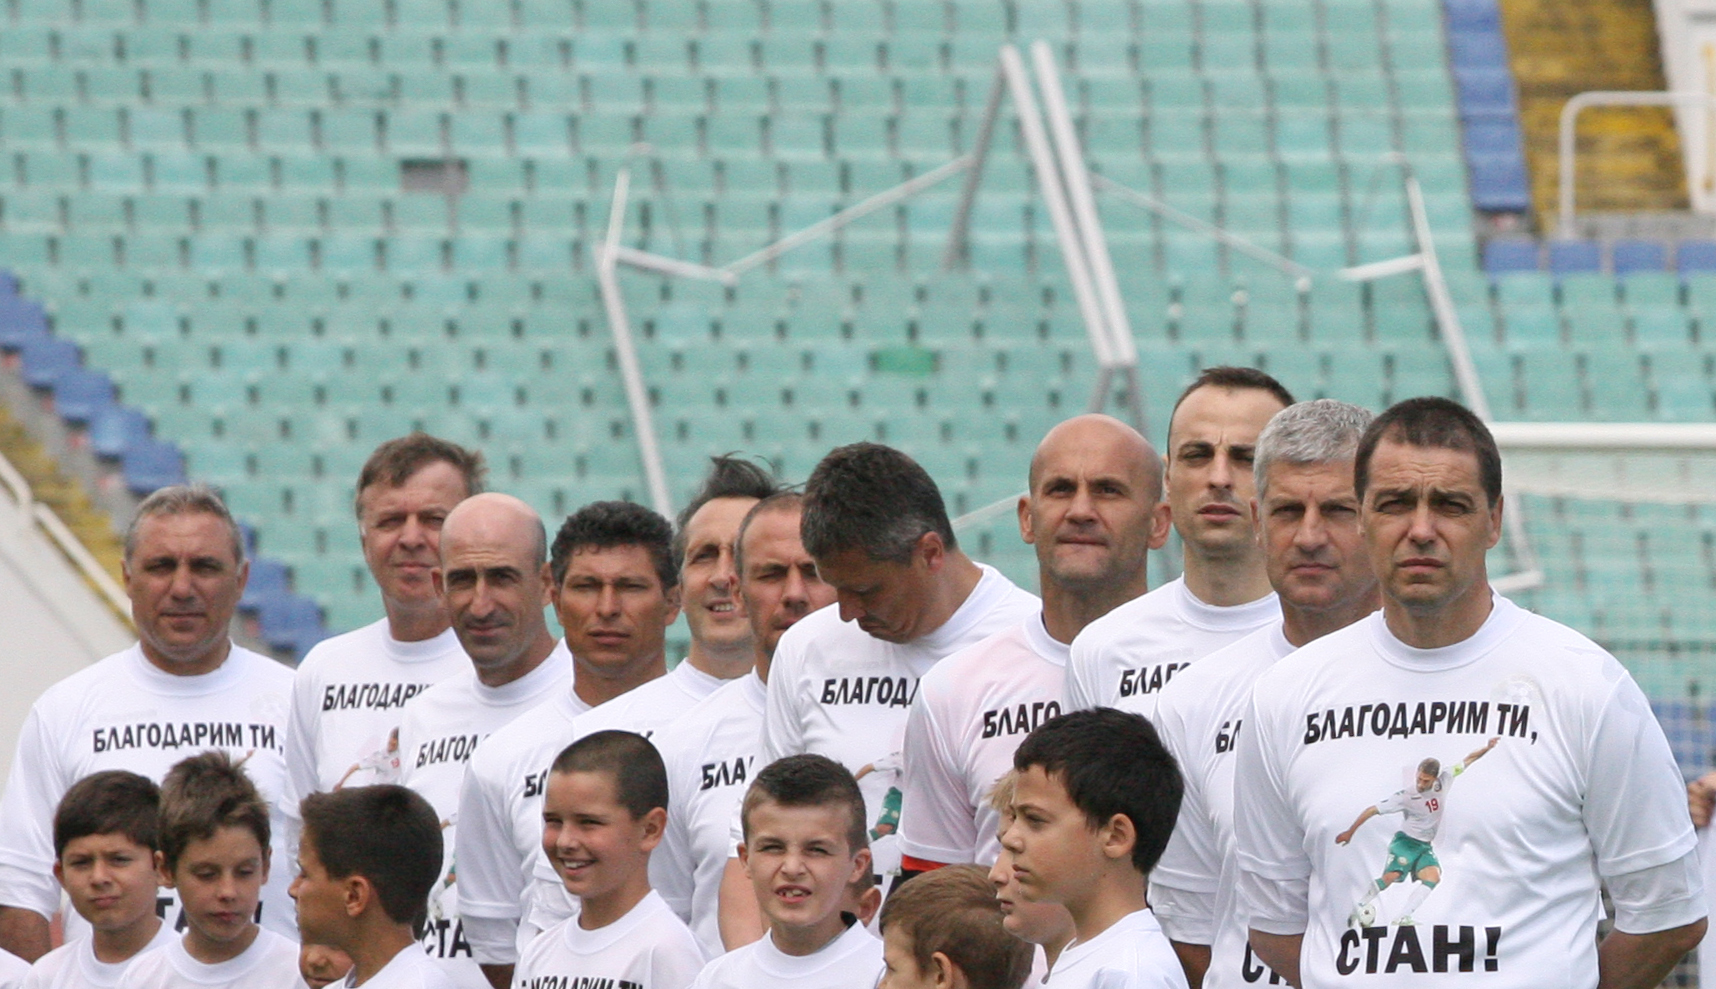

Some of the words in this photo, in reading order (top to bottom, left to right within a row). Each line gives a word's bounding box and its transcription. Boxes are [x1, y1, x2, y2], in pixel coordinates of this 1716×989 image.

[93, 722, 243, 753] БЛАГОДАРИМ
[249, 724, 284, 755] ТИ,
[982, 700, 1062, 739] БЛАГО
[1304, 700, 1489, 744] БЛАГОДАРИМ
[1497, 703, 1538, 745] ТИ,
[1425, 798, 1439, 813] 19
[421, 918, 473, 958] СТА
[1336, 924, 1502, 976] СТАН!
